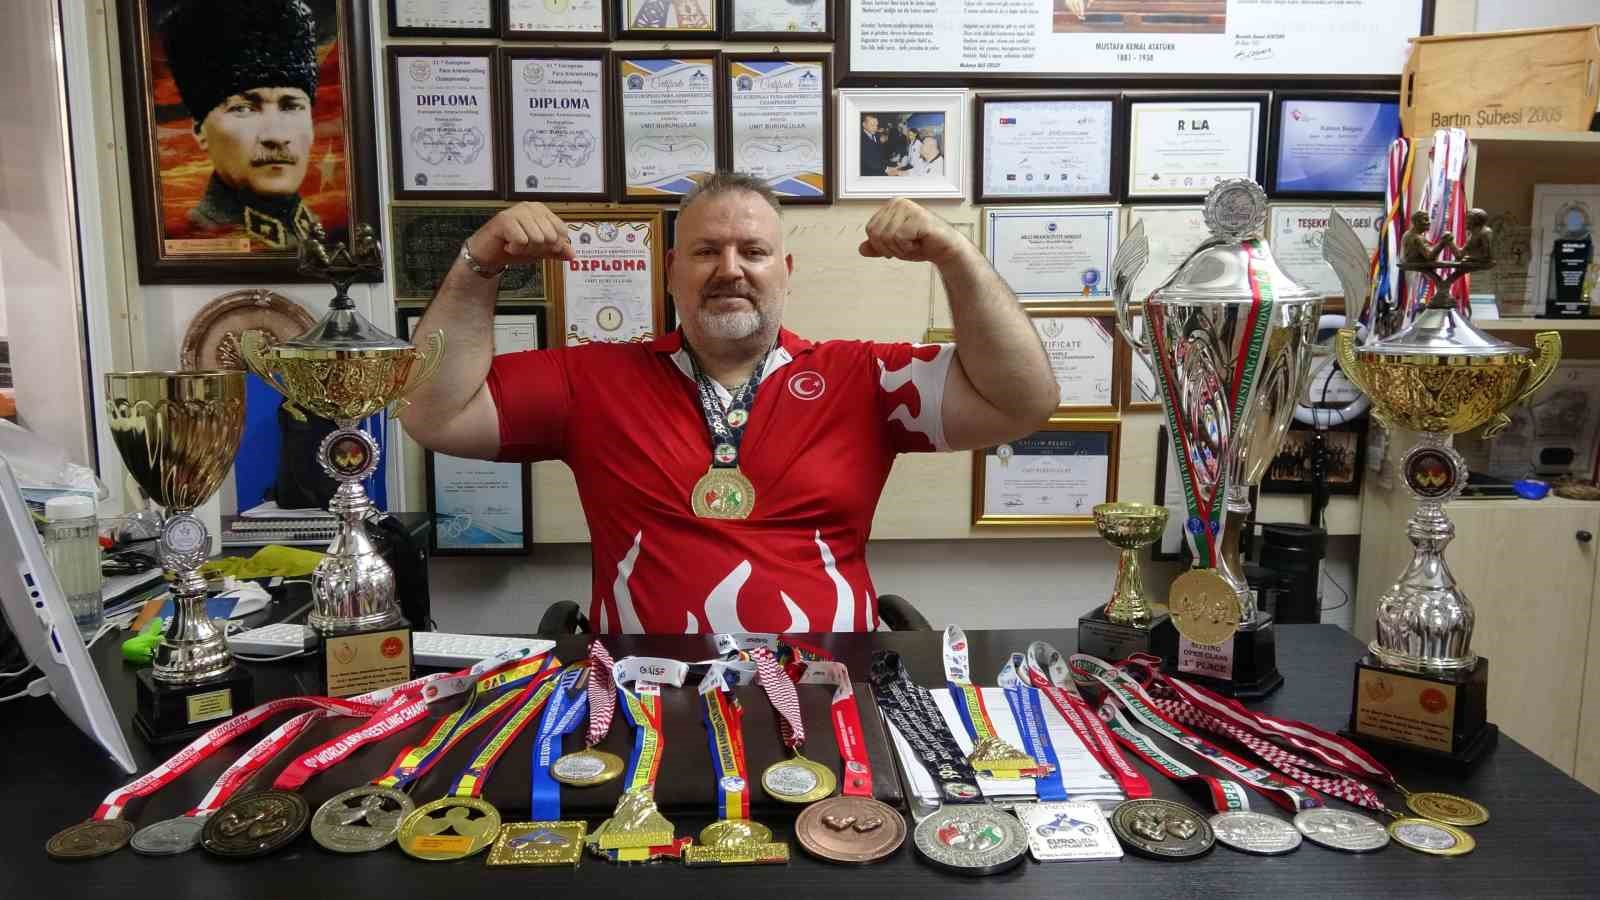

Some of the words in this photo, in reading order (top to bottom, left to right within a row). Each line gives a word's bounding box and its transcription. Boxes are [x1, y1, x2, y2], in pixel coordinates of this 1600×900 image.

[416, 94, 478, 106] DIPLOMA
[528, 97, 590, 109] DIPLOMA
[1298, 216, 1329, 230] TEŞEKK
[569, 259, 647, 272] DIPLOMA
[315, 739, 349, 765] WORLD
[1220, 779, 1241, 809] OPEN
